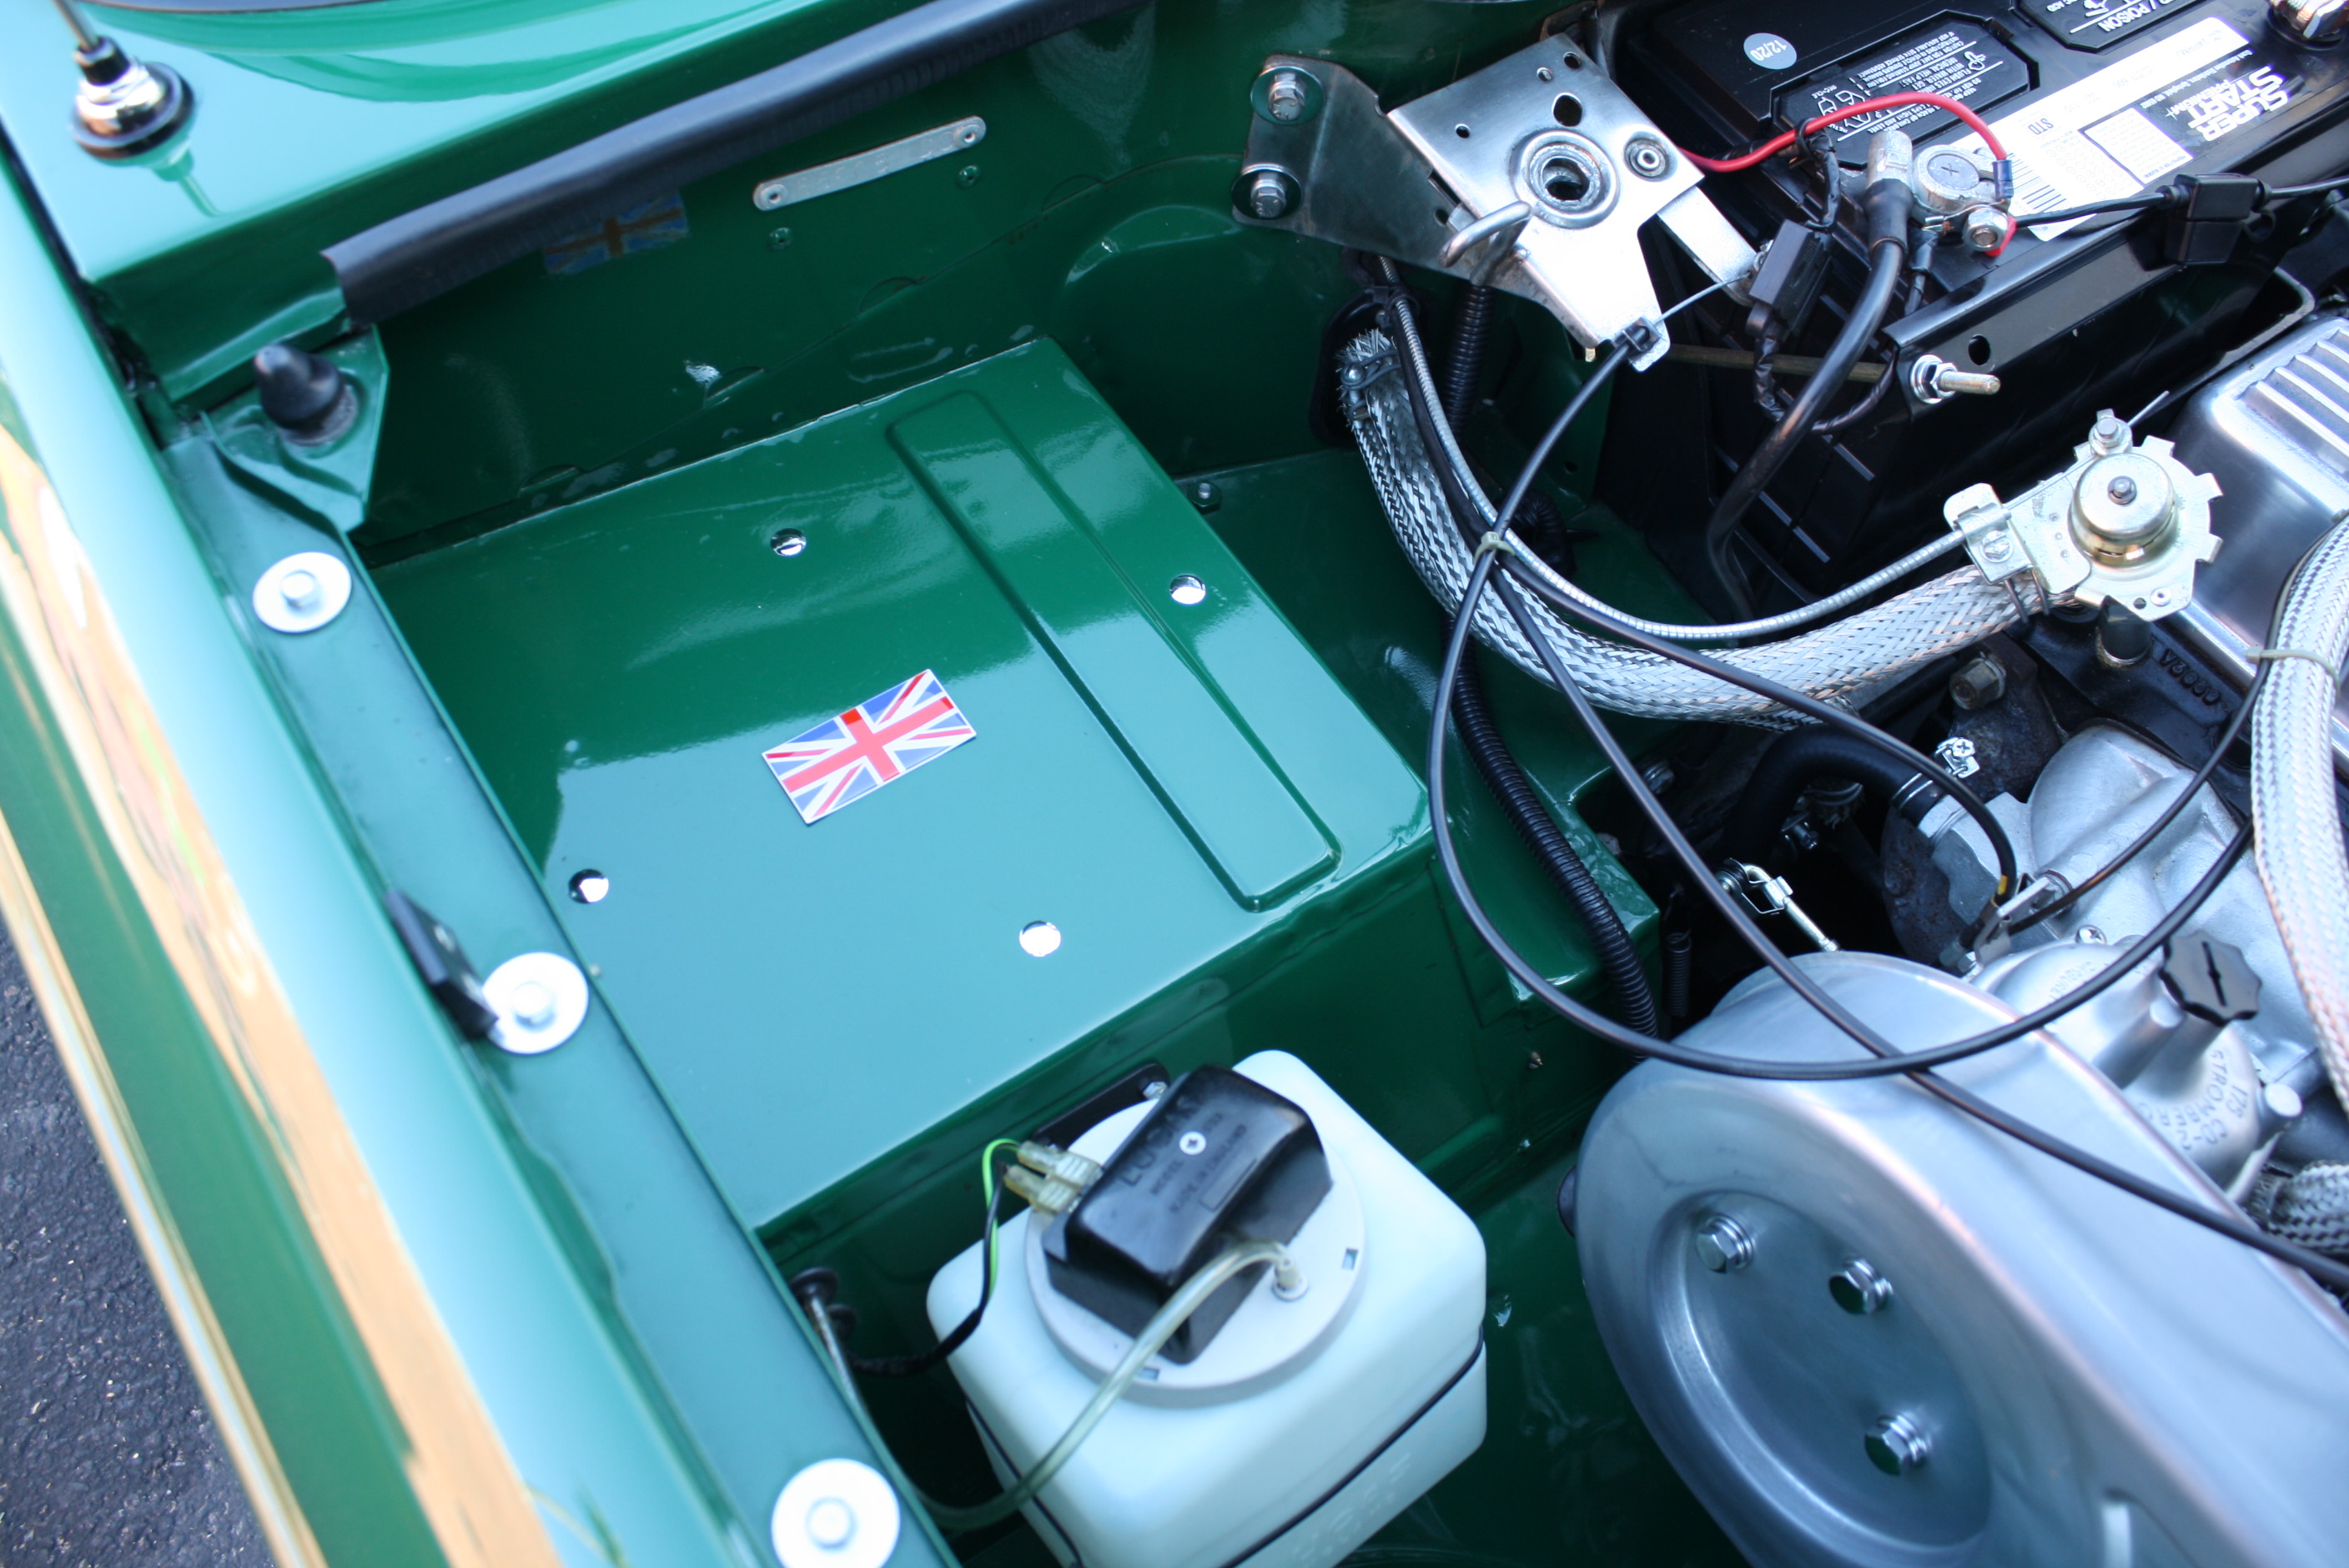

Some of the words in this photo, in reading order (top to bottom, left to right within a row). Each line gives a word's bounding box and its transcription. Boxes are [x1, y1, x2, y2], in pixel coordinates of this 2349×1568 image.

[2098, 3, 2150, 32] POISON
[1749, 39, 1787, 60] 12/20
[1929, 56, 1958, 73] MEDICAL
[1946, 62, 1964, 73] WITH
[1899, 76, 1916, 87] FAST
[1914, 68, 1932, 80] HELP
[1950, 68, 1971, 81] FLUSH
[1912, 80, 1926, 90] GET
[1934, 78, 1952, 88] EYES
[2168, 78, 2231, 114] PREMIUM
[2185, 65, 2282, 128] START
[2200, 85, 2289, 142] SUPER
[2025, 117, 2055, 136] STD
